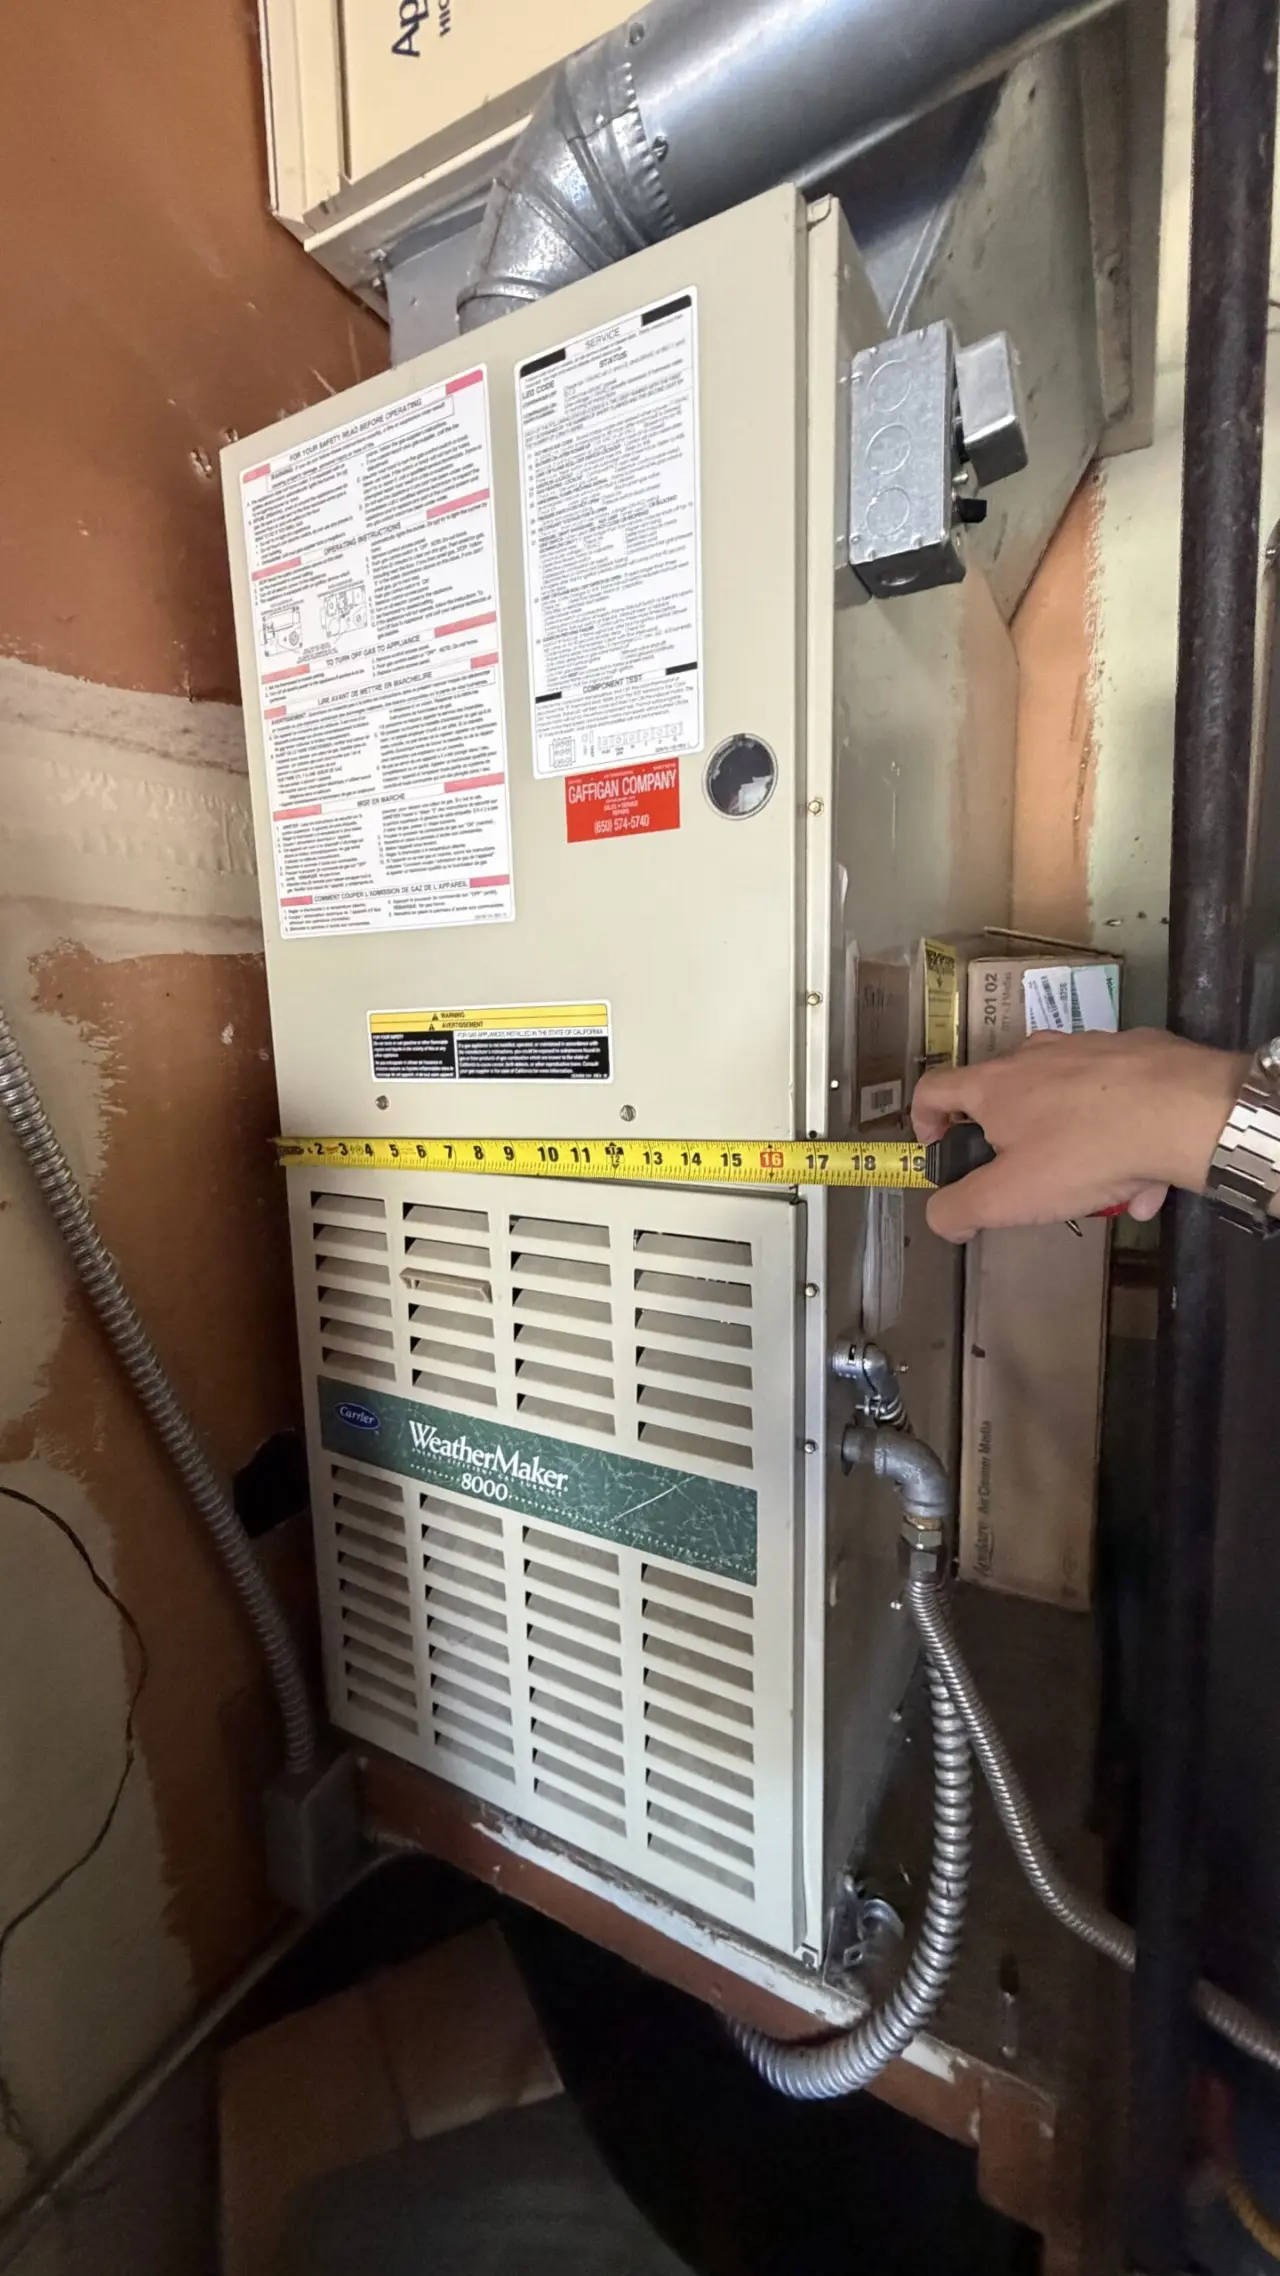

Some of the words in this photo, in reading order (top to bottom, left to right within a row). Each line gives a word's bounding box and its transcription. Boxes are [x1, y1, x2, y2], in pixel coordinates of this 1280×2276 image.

[585, 326, 620, 350] SERVICE
[599, 349, 627, 368] STATUS
[289, 451, 300, 462] FOR
[302, 443, 317, 457] YOUR
[319, 433, 340, 449] SAFETY
[341, 425, 358, 439] READ
[359, 414, 384, 431] BEFORE
[385, 397, 421, 420] OPERATING
[323, 537, 355, 555] OPERATING
[357, 521, 400, 543] INSTRUCTIONS
[326, 658, 334, 666] TO
[335, 653, 349, 664] TURN
[350, 650, 362, 660] OFF
[363, 646, 375, 656] GAS
[377, 644, 384, 652] TO
[386, 634, 420, 650] APPLIANCE
[350, 689, 358, 697] DE
[384, 681, 392, 689] EN
[582, 678, 623, 693] COMPONENT
[625, 674, 642, 684] TEST
[568, 779, 620, 804] GAFFIGAN
[622, 769, 677, 795] COMPANY
[594, 818, 613, 835] (650)
[314, 893, 340, 902] COMMENT
[410, 884, 423, 892] GAZ
[984, 972, 997, 993] 02
[984, 998, 997, 1026] 201
[314, 1142, 324, 1154] 2
[338, 1142, 348, 1155] 3
[365, 1143, 373, 1157] 4
[388, 1144, 399, 1158] 5
[417, 1144, 427, 1158] 6
[444, 1144, 453, 1159] 7
[474, 1145, 485, 1160] 8
[504, 1145, 514, 1161] 9
[537, 1147, 559, 1163] 10
[570, 1148, 591, 1163] 11
[643, 1151, 663, 1165] 13
[681, 1152, 702, 1166] 14
[720, 1153, 742, 1167] 15
[762, 1153, 783, 1168] 16
[805, 1154, 829, 1170] 17
[851, 1155, 876, 1171] 18
[900, 1156, 926, 1172] 19
[339, 1405, 375, 1425] Carrier
[409, 1420, 568, 1491] WeatherMaker
[461, 1473, 508, 1501] 8000
